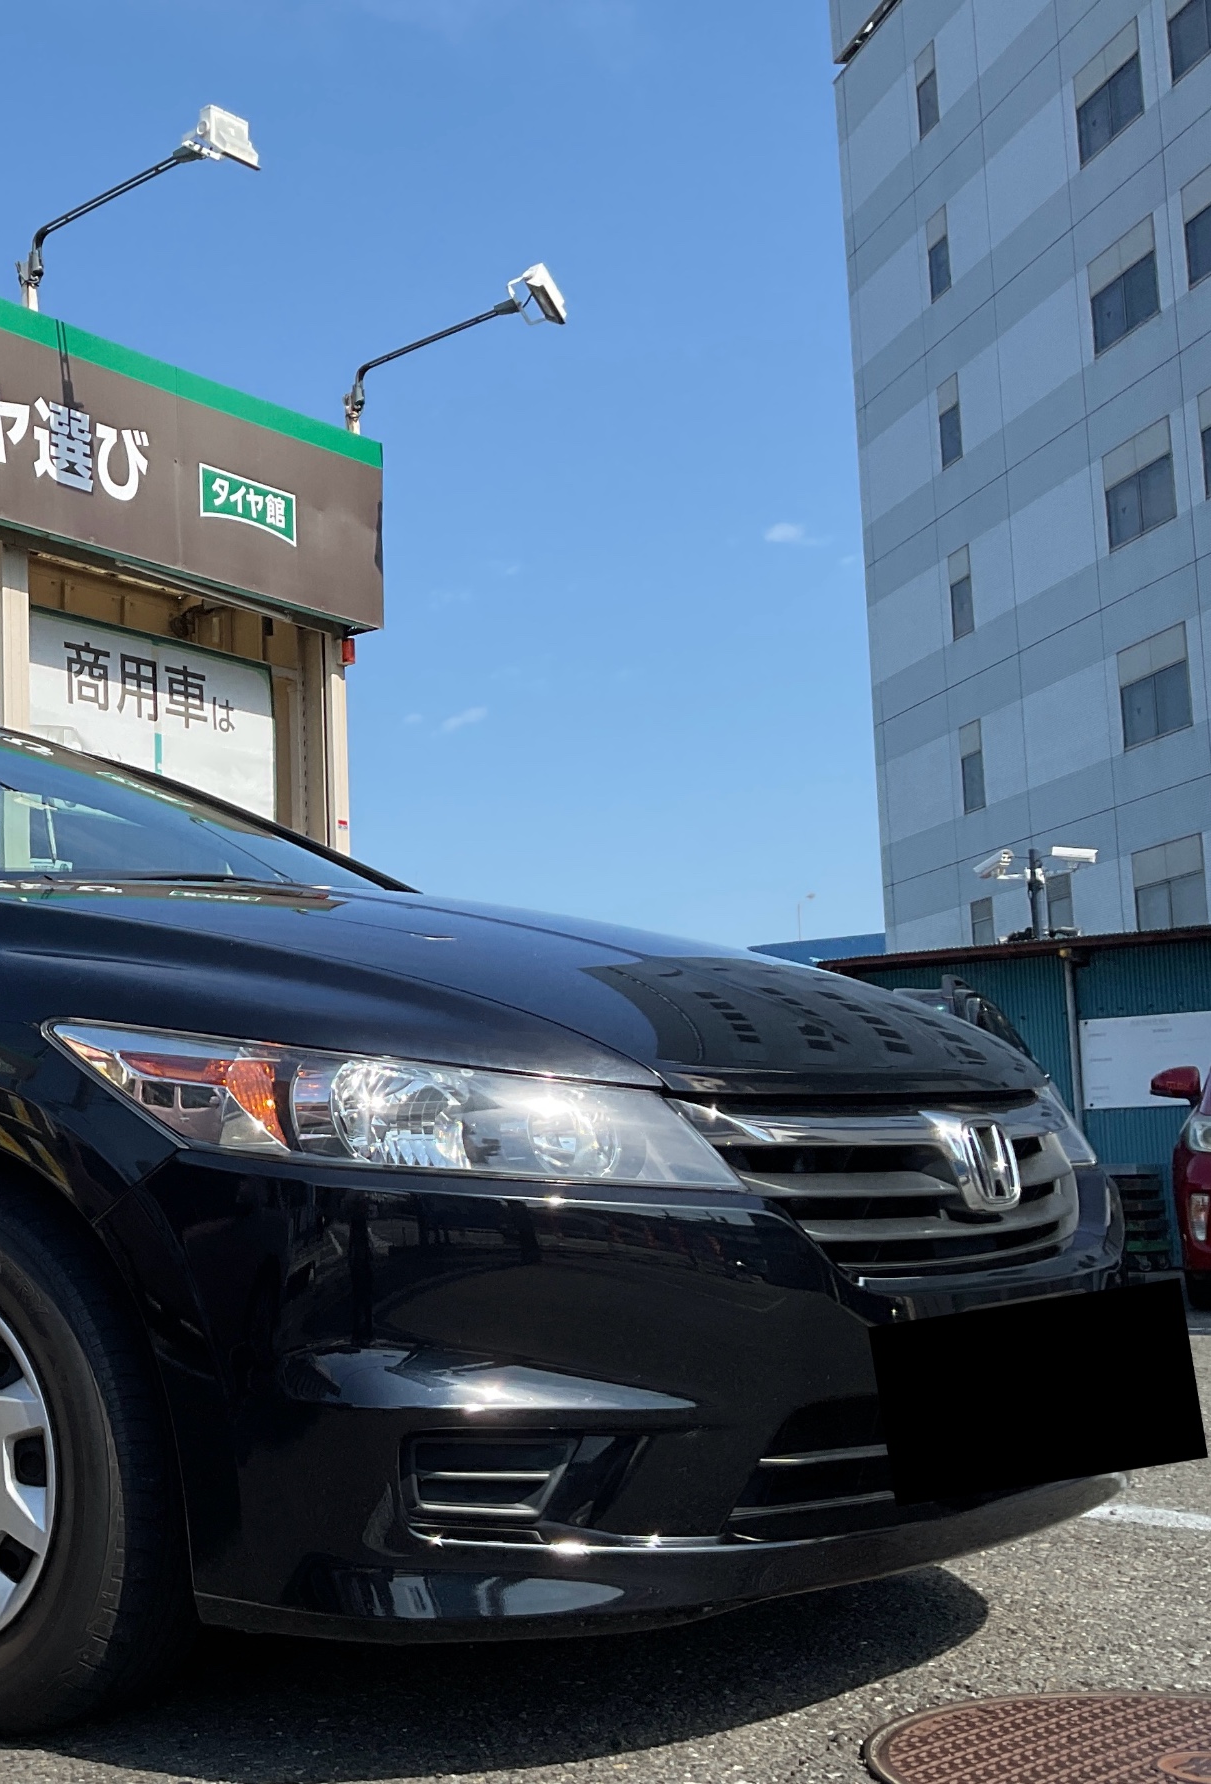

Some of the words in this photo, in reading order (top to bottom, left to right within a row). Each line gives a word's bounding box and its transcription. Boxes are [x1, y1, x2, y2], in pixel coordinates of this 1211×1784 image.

[211, 477, 286, 529] タイヤ館
[64, 641, 235, 733] 商用車は
